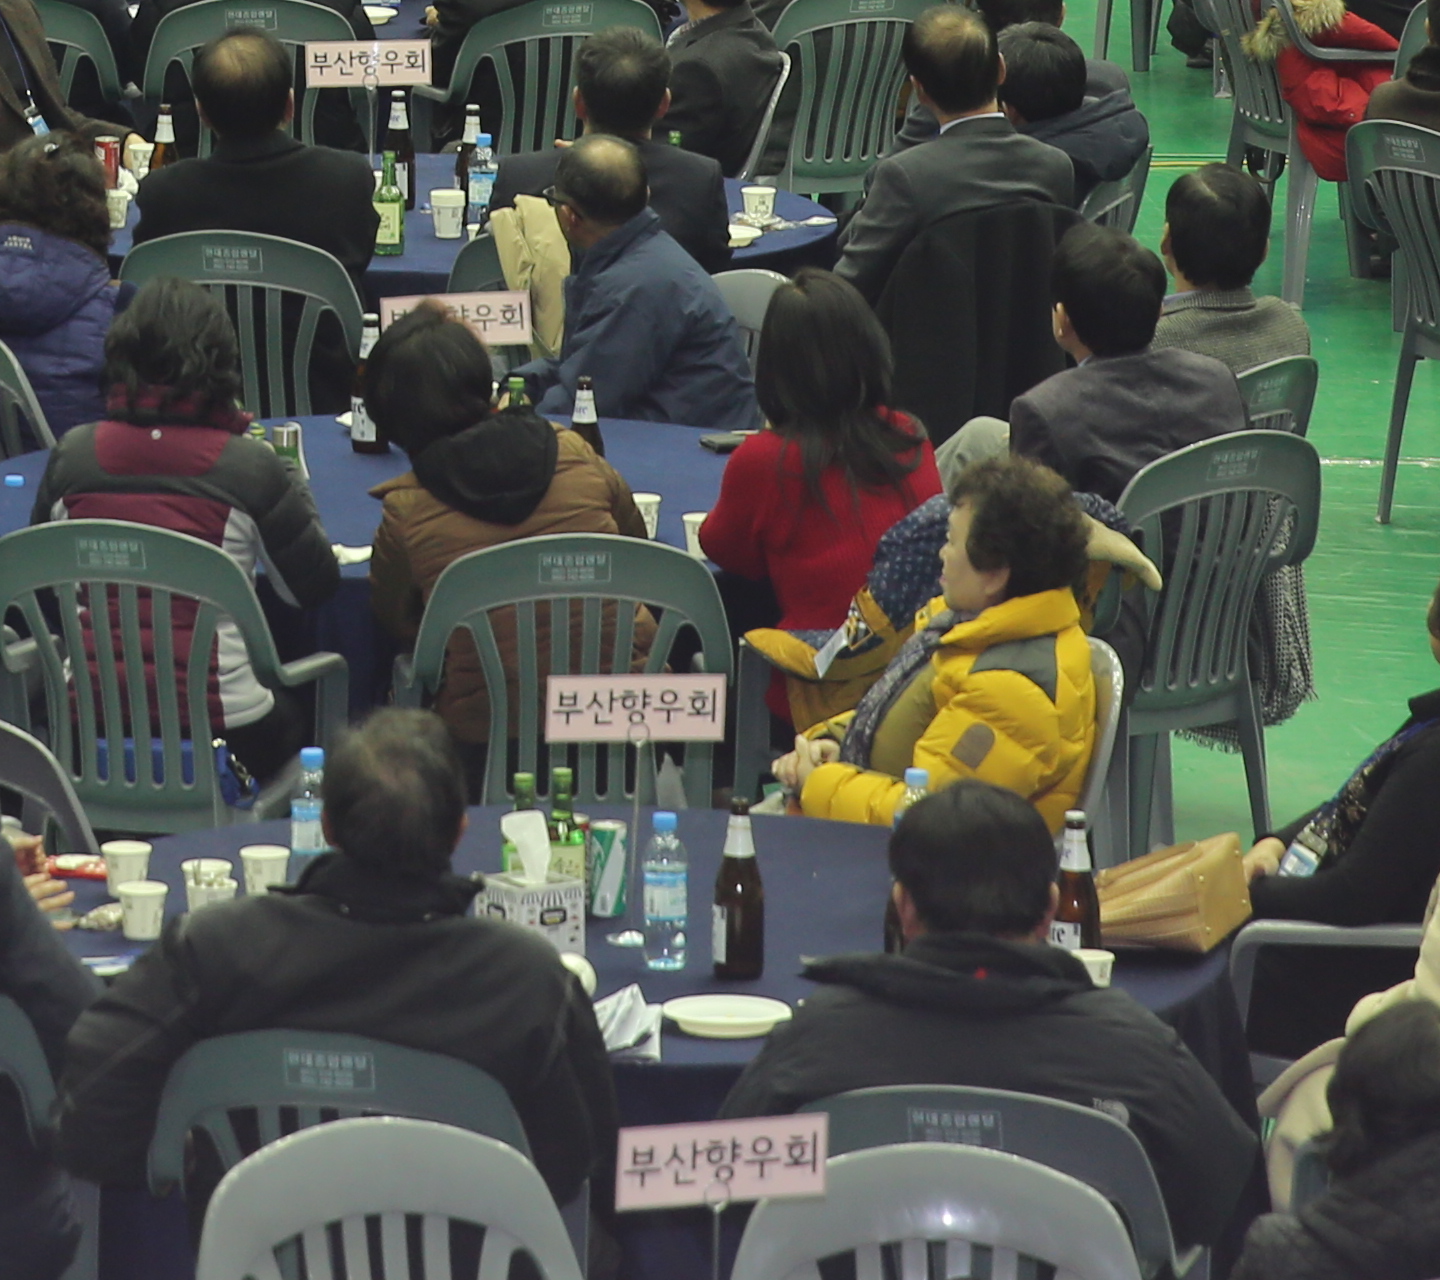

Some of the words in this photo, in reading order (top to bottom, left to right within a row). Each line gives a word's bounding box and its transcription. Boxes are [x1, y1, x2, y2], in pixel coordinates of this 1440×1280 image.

[309, 47, 427, 77] 부산향우회
[551, 686, 718, 729] 부산향우회
[622, 1130, 820, 1188] 부산향우회
